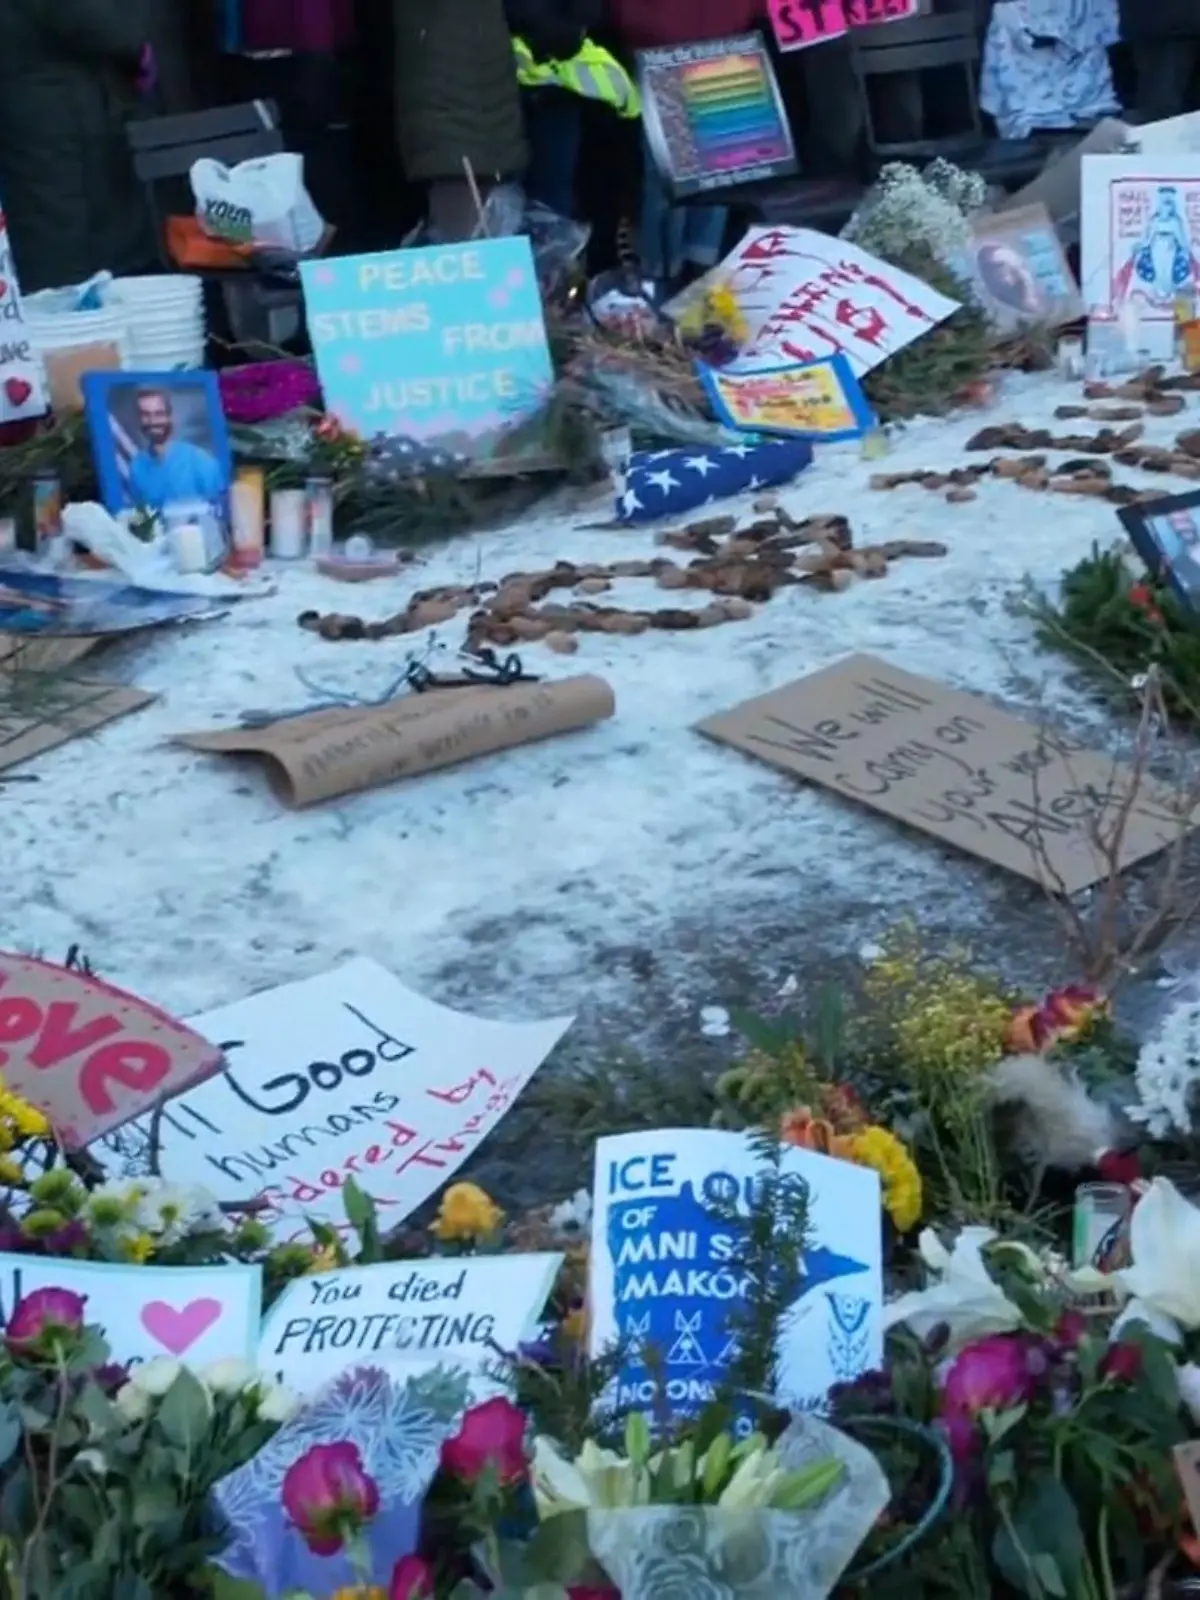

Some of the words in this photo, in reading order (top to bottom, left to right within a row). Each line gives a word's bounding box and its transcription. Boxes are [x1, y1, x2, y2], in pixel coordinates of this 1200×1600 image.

[360, 251, 484, 291] PEACE
[313, 303, 430, 342] STEMS
[443, 317, 546, 357] FROM
[363, 368, 518, 412] JUSTICE
[745, 714, 861, 763] We
[852, 677, 933, 727] will
[936, 713, 985, 744] on
[911, 768, 998, 832] your
[985, 782, 1124, 851] Alex
[0, 966, 172, 1115] ove
[219, 1002, 417, 1114] Good
[206, 1091, 399, 1181] humans
[608, 1154, 677, 1194] ICE
[622, 1206, 657, 1229] OF
[617, 1231, 697, 1266] MNI
[310, 1277, 361, 1304] You
[388, 1269, 467, 1302] died
[623, 1267, 776, 1300] MAKÓ
[275, 1312, 495, 1354] PROTECTING
[620, 1380, 658, 1404] NO
[666, 1379, 721, 1401] ON
